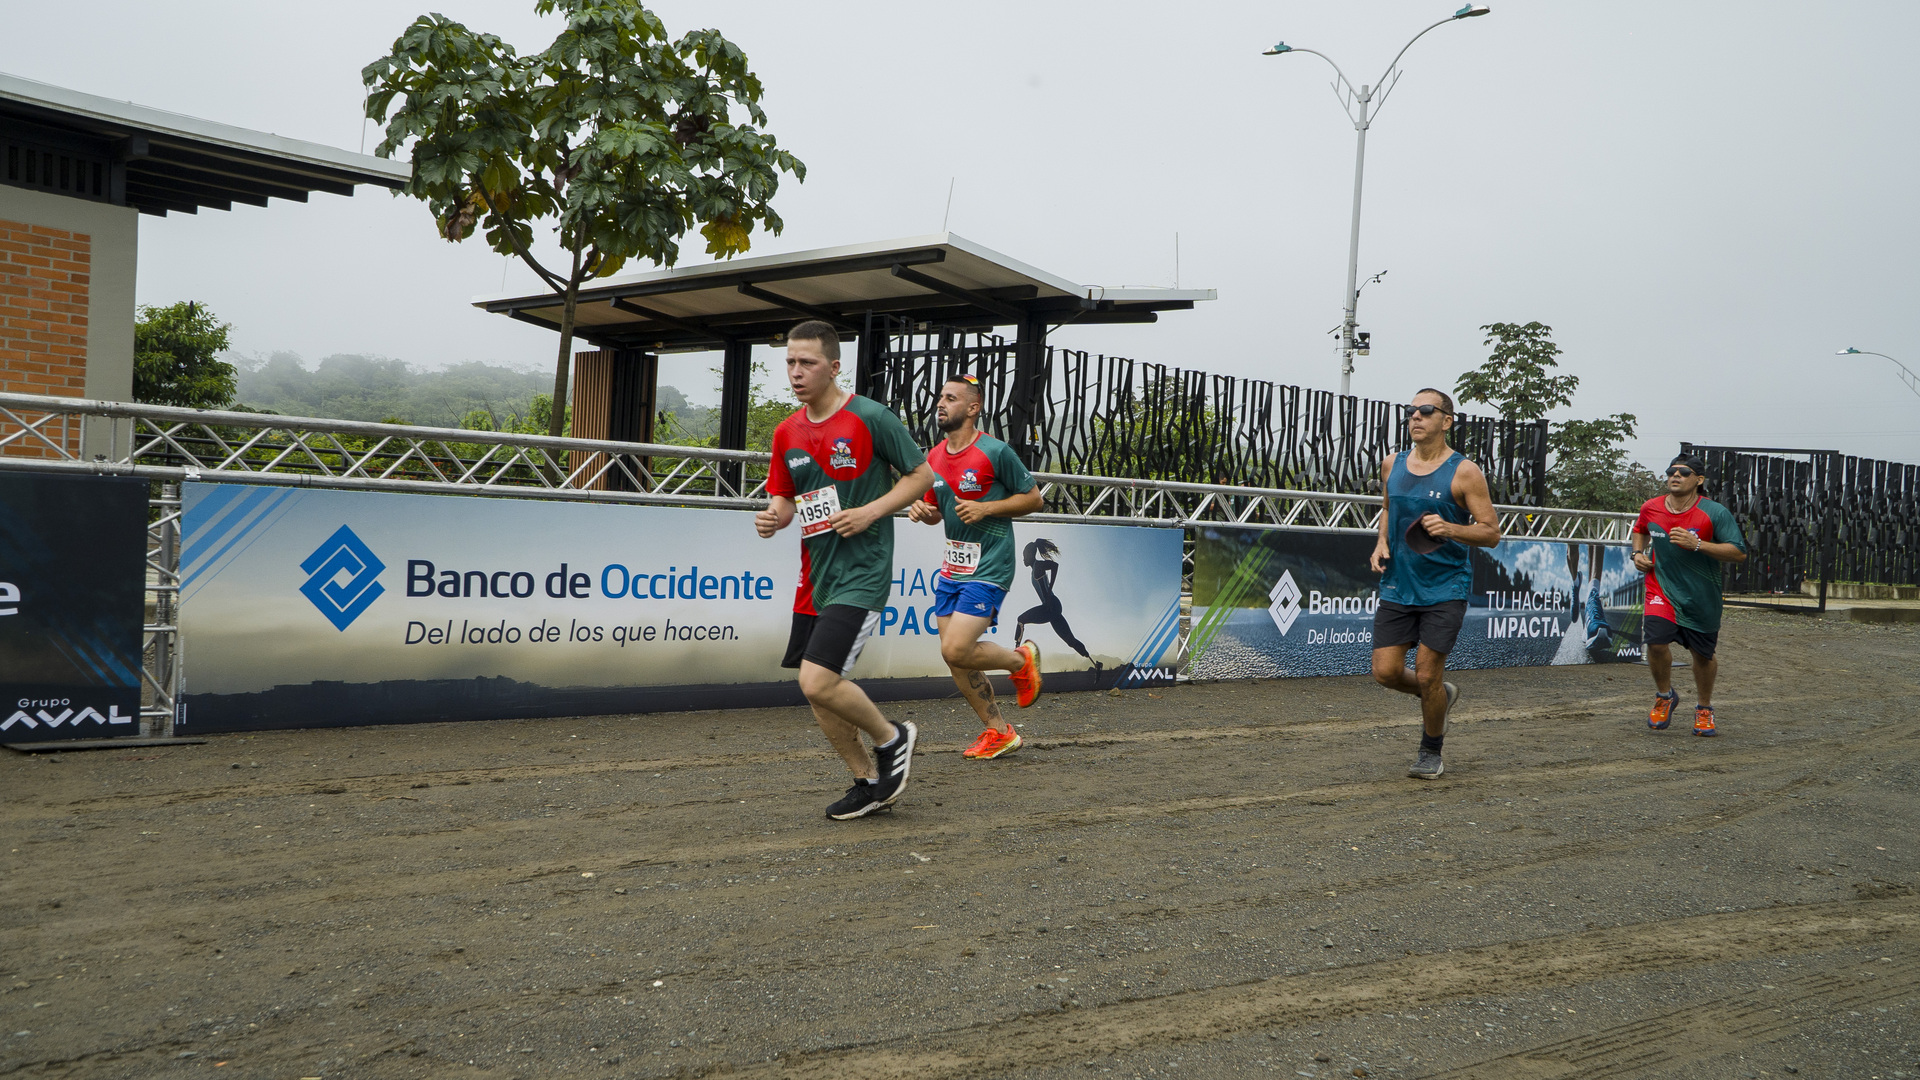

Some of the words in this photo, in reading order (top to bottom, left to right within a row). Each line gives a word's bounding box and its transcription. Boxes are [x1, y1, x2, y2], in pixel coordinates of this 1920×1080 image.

[800, 502, 831, 522] 1956
[948, 550, 971, 564] 1351
[407, 559, 534, 598] Banco
[545, 563, 590, 598] de
[600, 563, 774, 600] Occidente
[1308, 590, 1362, 614] Banco
[1486, 590, 1506, 612] TU
[1511, 590, 1565, 614] HACER,
[405, 620, 452, 645] Del
[460, 619, 522, 644] lado
[529, 618, 562, 643] de
[569, 618, 604, 642] los
[612, 620, 656, 648] que
[664, 618, 740, 641] hacen.
[1307, 628, 1328, 644] Del
[1330, 628, 1356, 644] lado
[1357, 626, 1372, 642] de
[1488, 616, 1565, 638] IMPACTA.
[1616, 648, 1642, 656] AVAL
[1128, 668, 1174, 680] AVAL
[18, 698, 70, 708] Grupo
[0, 705, 132, 731] AVAL
